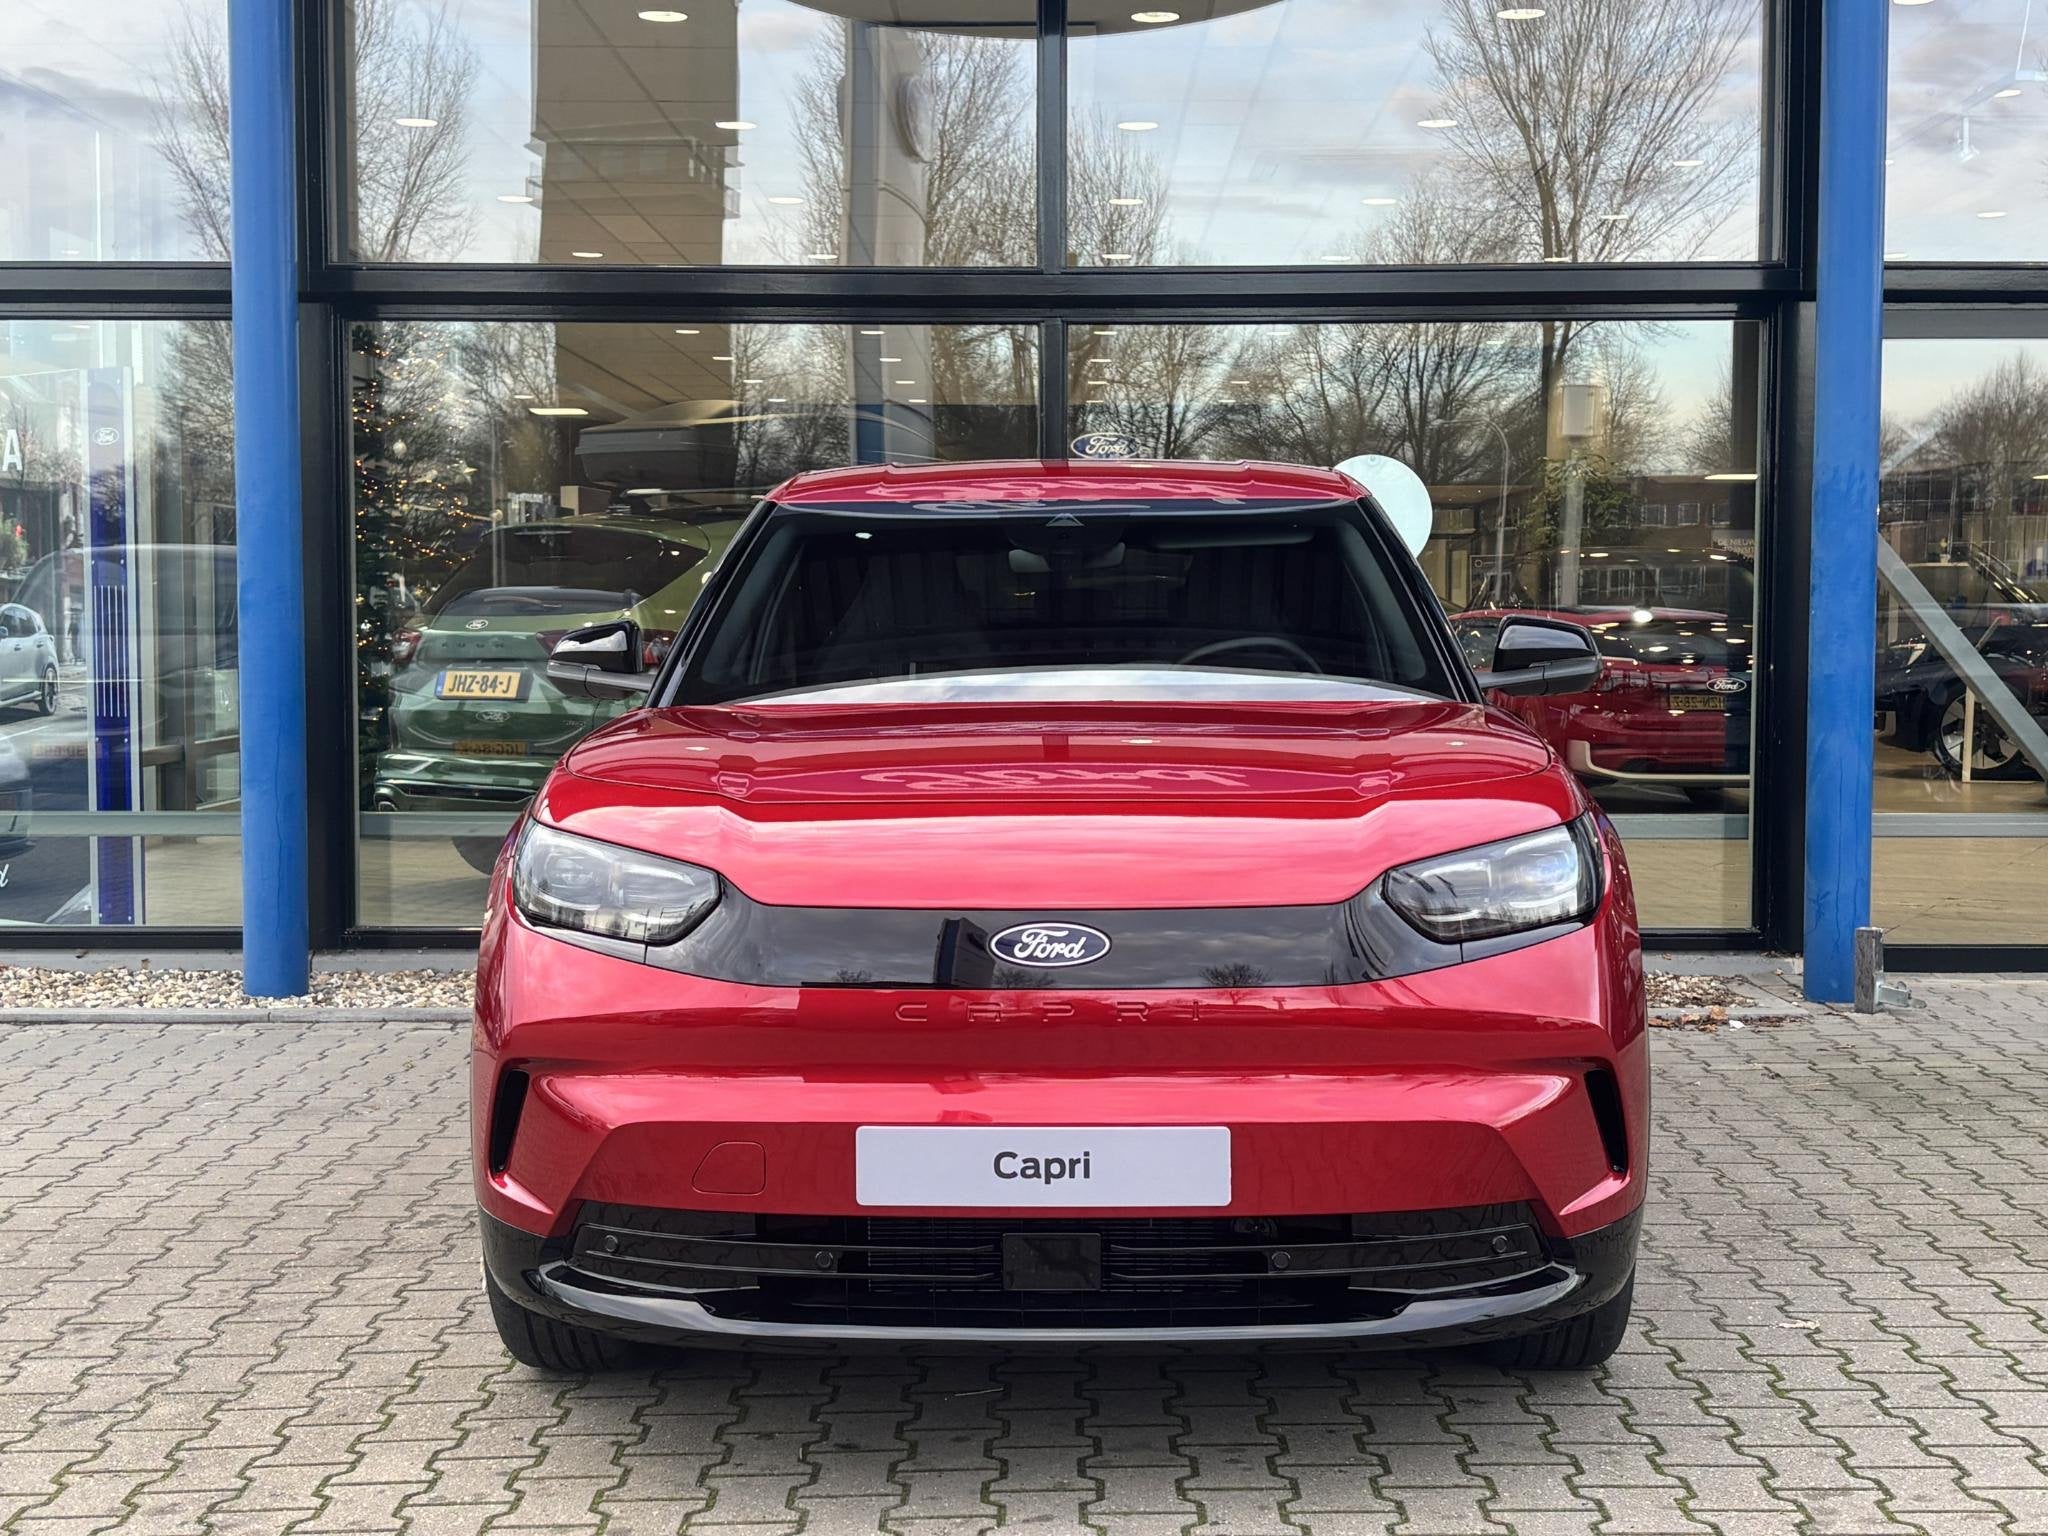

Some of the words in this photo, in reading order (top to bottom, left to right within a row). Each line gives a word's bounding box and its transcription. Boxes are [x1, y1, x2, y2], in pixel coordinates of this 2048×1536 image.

[1085, 436, 1129, 455] Ford
[448, 674, 512, 694] JHZ-84-J
[1013, 928, 1087, 960] Ford
[893, 1000, 1202, 1023] CAPRI
[993, 1151, 1091, 1185] Capri
